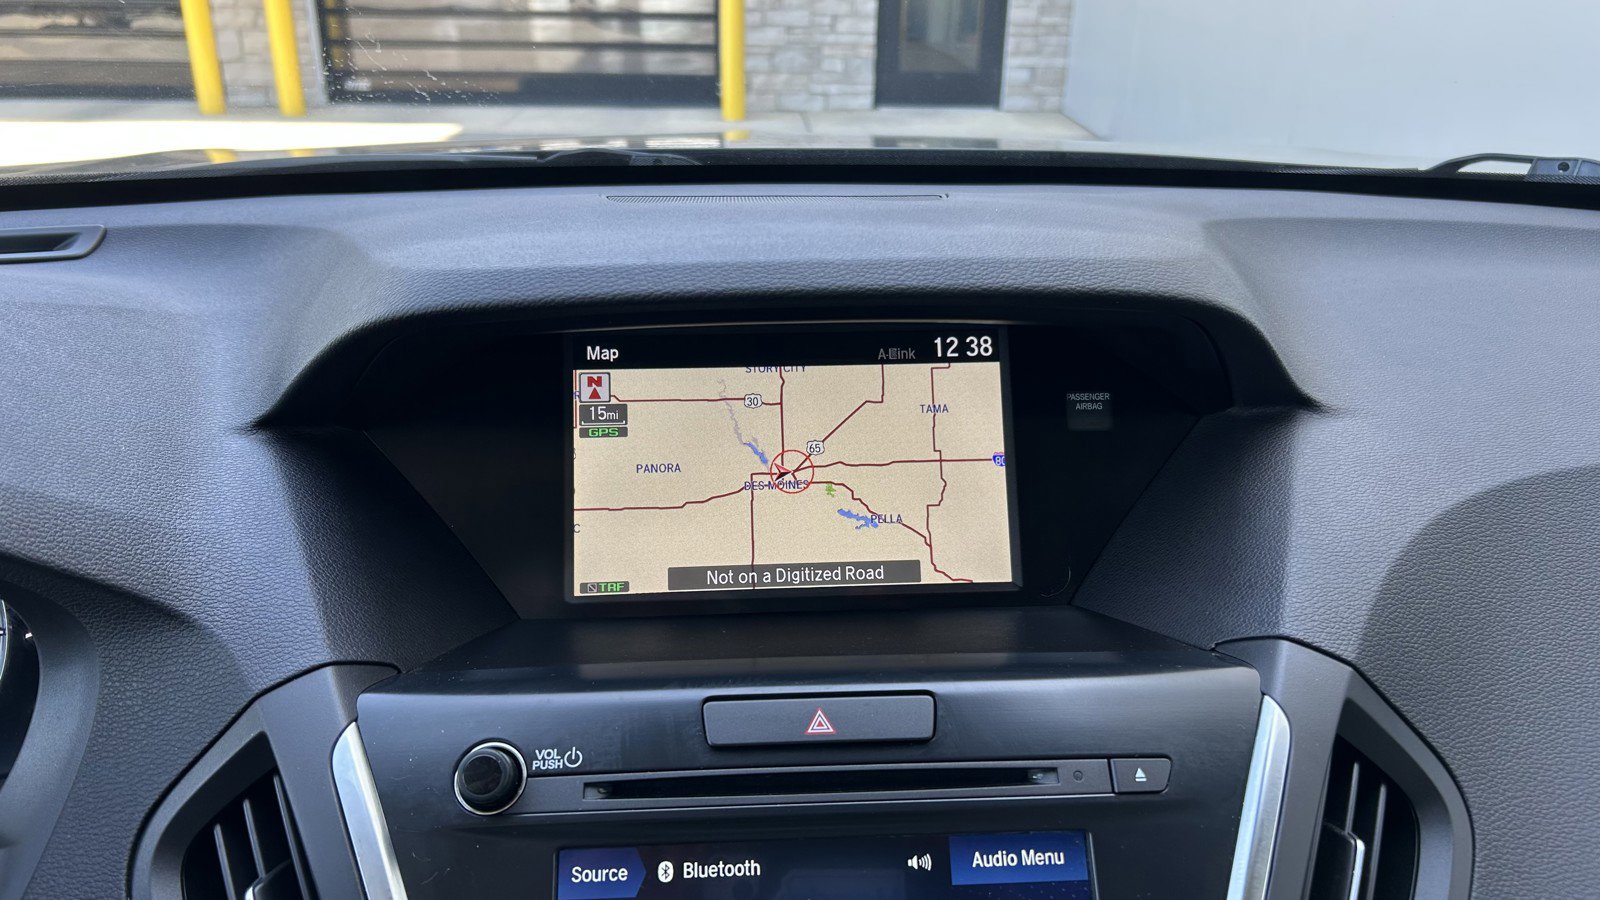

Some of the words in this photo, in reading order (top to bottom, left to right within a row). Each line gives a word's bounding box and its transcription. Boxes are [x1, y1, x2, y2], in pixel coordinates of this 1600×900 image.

[586, 346, 619, 362] Map
[587, 376, 603, 387] N
[746, 396, 759, 407] 30
[1066, 392, 1110, 401] PASSENGER
[920, 404, 949, 414] TAMA
[1075, 402, 1103, 410] AIRBAG
[588, 428, 619, 437] GPS
[809, 444, 821, 454] 65
[636, 463, 681, 474] PANORA
[870, 514, 903, 525] PELLA
[706, 569, 734, 585] Not
[738, 571, 758, 584] on
[762, 570, 771, 583] a
[776, 566, 842, 586] Digitized
[846, 565, 885, 580] Road
[535, 749, 561, 760] VOL
[532, 760, 564, 771] PUSH
[972, 850, 1018, 868] Audio
[1021, 849, 1065, 867] Menu
[571, 866, 629, 883] Source
[683, 860, 761, 879] Bluetooth
